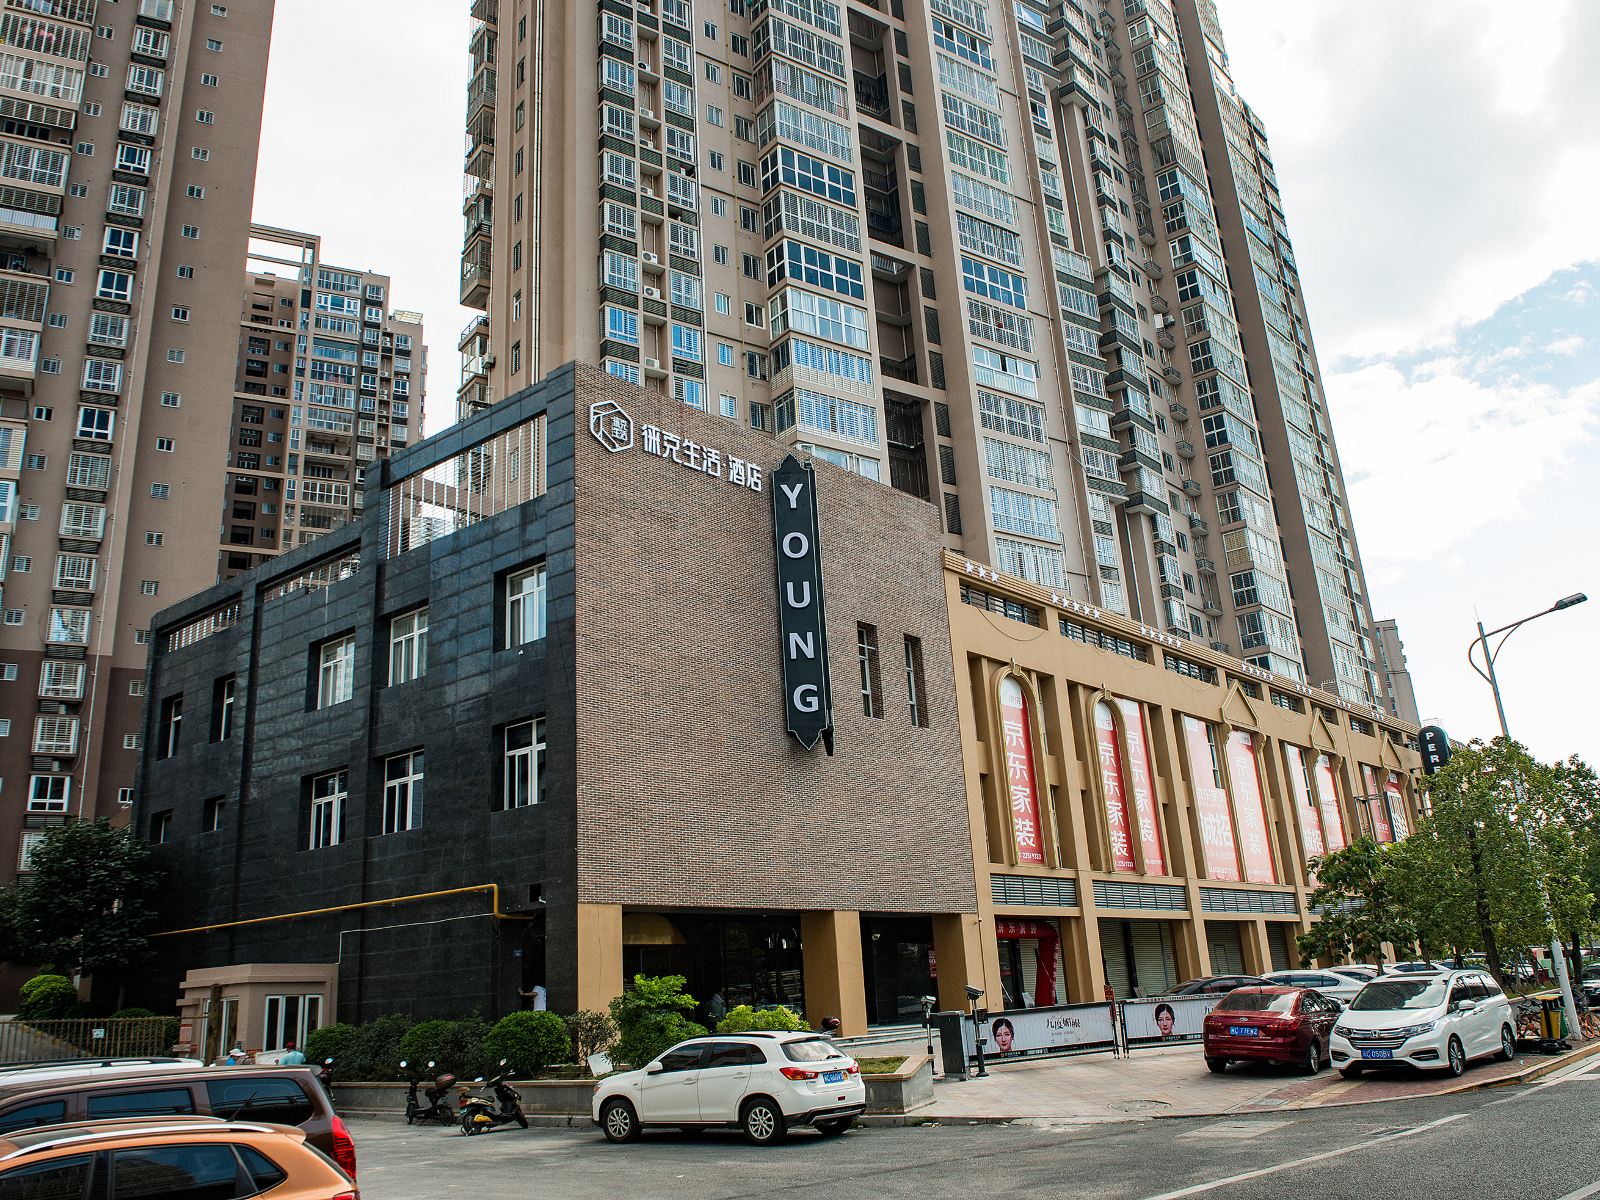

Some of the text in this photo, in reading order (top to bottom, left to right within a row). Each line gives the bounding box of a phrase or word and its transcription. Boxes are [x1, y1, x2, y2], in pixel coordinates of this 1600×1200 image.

[779, 483, 820, 713] YOUNG
[1002, 719, 1037, 848] 京东家装
[1098, 741, 1129, 857] 京东家装
[1126, 729, 1155, 843] 京东家装
